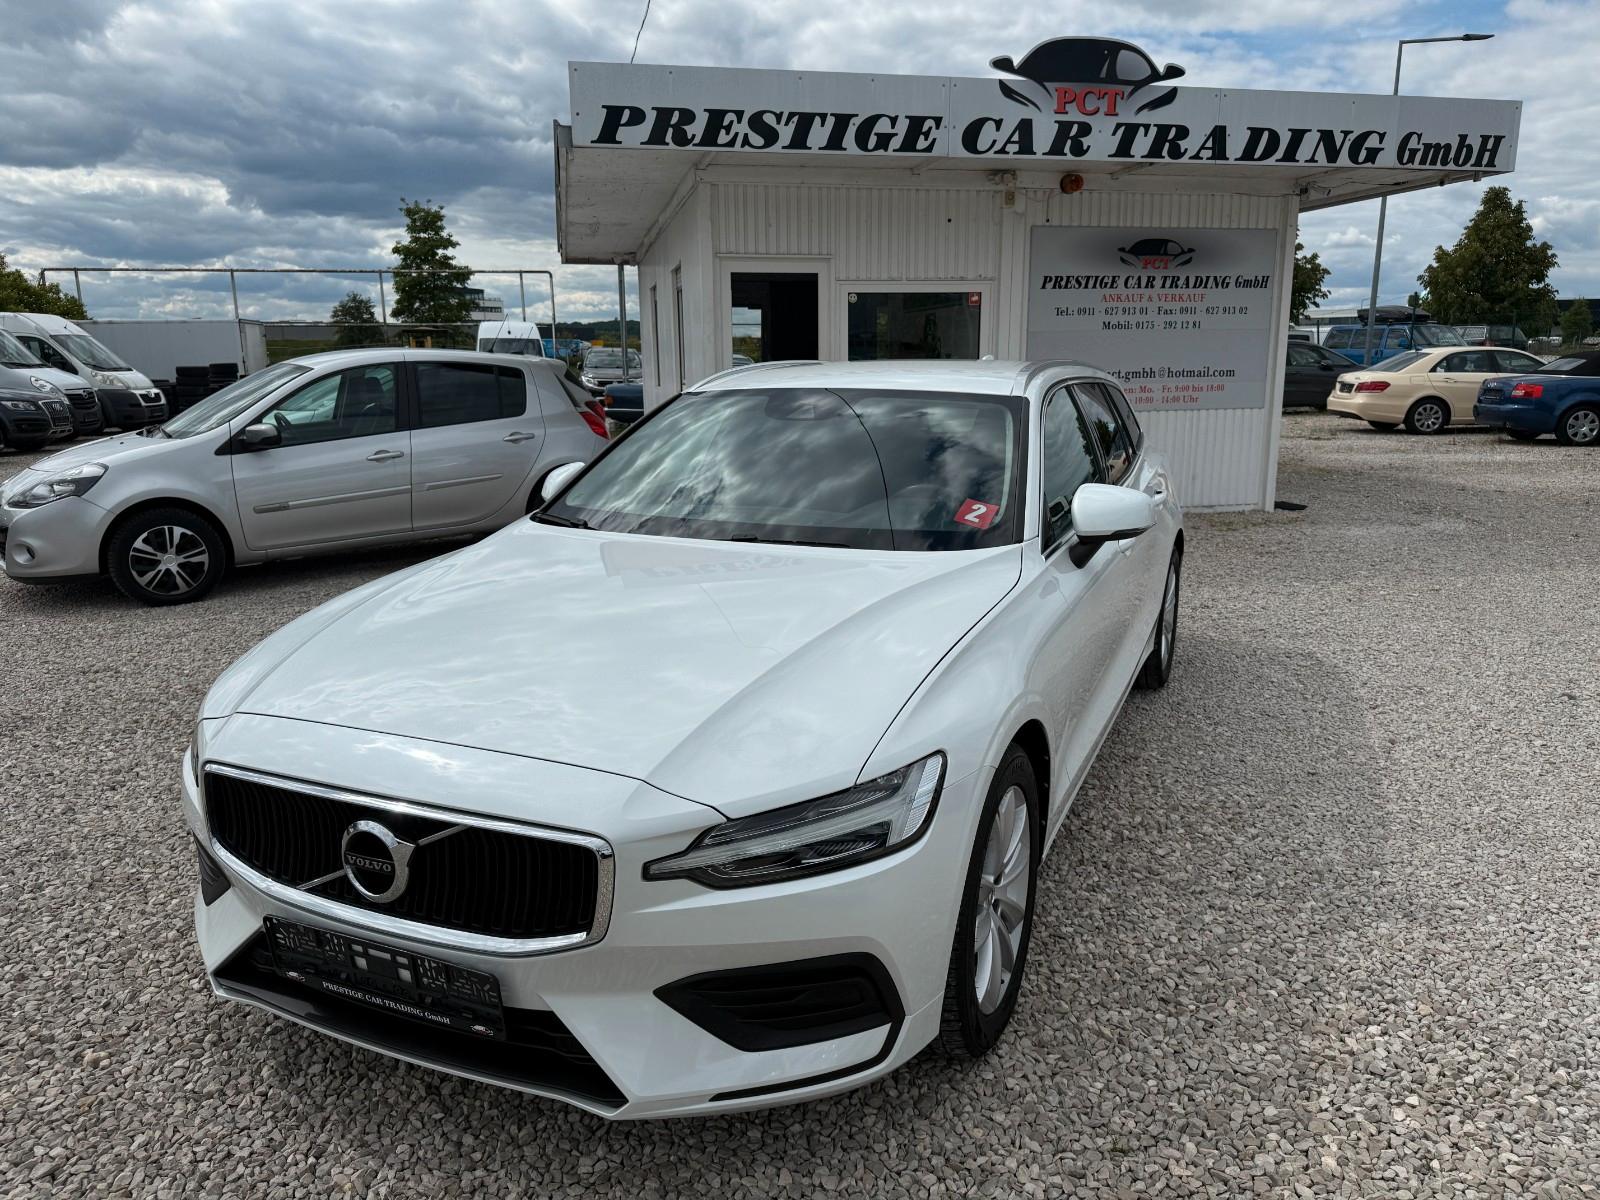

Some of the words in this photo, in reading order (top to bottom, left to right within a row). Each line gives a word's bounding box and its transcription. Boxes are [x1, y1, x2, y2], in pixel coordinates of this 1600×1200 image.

[1054, 86, 1125, 116] PCT
[590, 104, 943, 154] PRESTIGE
[961, 116, 1093, 158] CAR
[1108, 121, 1388, 166] TRADING
[1396, 130, 1506, 169] GmbH
[1040, 275, 1120, 290] PRESTIGE
[1123, 275, 1156, 290] CAR
[1160, 275, 1231, 289] TRADING
[1235, 274, 1270, 289] GmbH
[1101, 293, 1144, 303] ANKAUF
[1157, 293, 1206, 303] VERKAUF
[1055, 306, 1074, 316] Tel.:
[1077, 306, 1095, 316] 0911
[1104, 306, 1119, 316] 627
[1122, 306, 1136, 316] 913
[1139, 306, 1148, 316] 01
[1157, 306, 1177, 315] Fax:
[1180, 306, 1197, 315] 0911
[1205, 306, 1220, 315] 627
[1222, 306, 1236, 315] 913
[1239, 306, 1248, 315] 02
[1102, 320, 1133, 331] Mobil:
[1135, 320, 1155, 330] 0175
[1163, 320, 1178, 330] 292
[1181, 320, 1190, 330] 12
[1192, 320, 1201, 329] 81
[1139, 385, 1155, 394] Mo.
[1162, 384, 1172, 393] Fr.
[1174, 384, 1189, 393] 9:00
[1191, 383, 1203, 393] bis
[1183, 395, 1199, 404] Uhr
[963, 503, 987, 523] 2
[346, 854, 391, 872] VOLVO
[322, 981, 364, 1000] PRESTIGE
[365, 994, 383, 1006] CAR
[383, 999, 424, 1017] TRADING
[424, 1011, 451, 1025] GmbH
